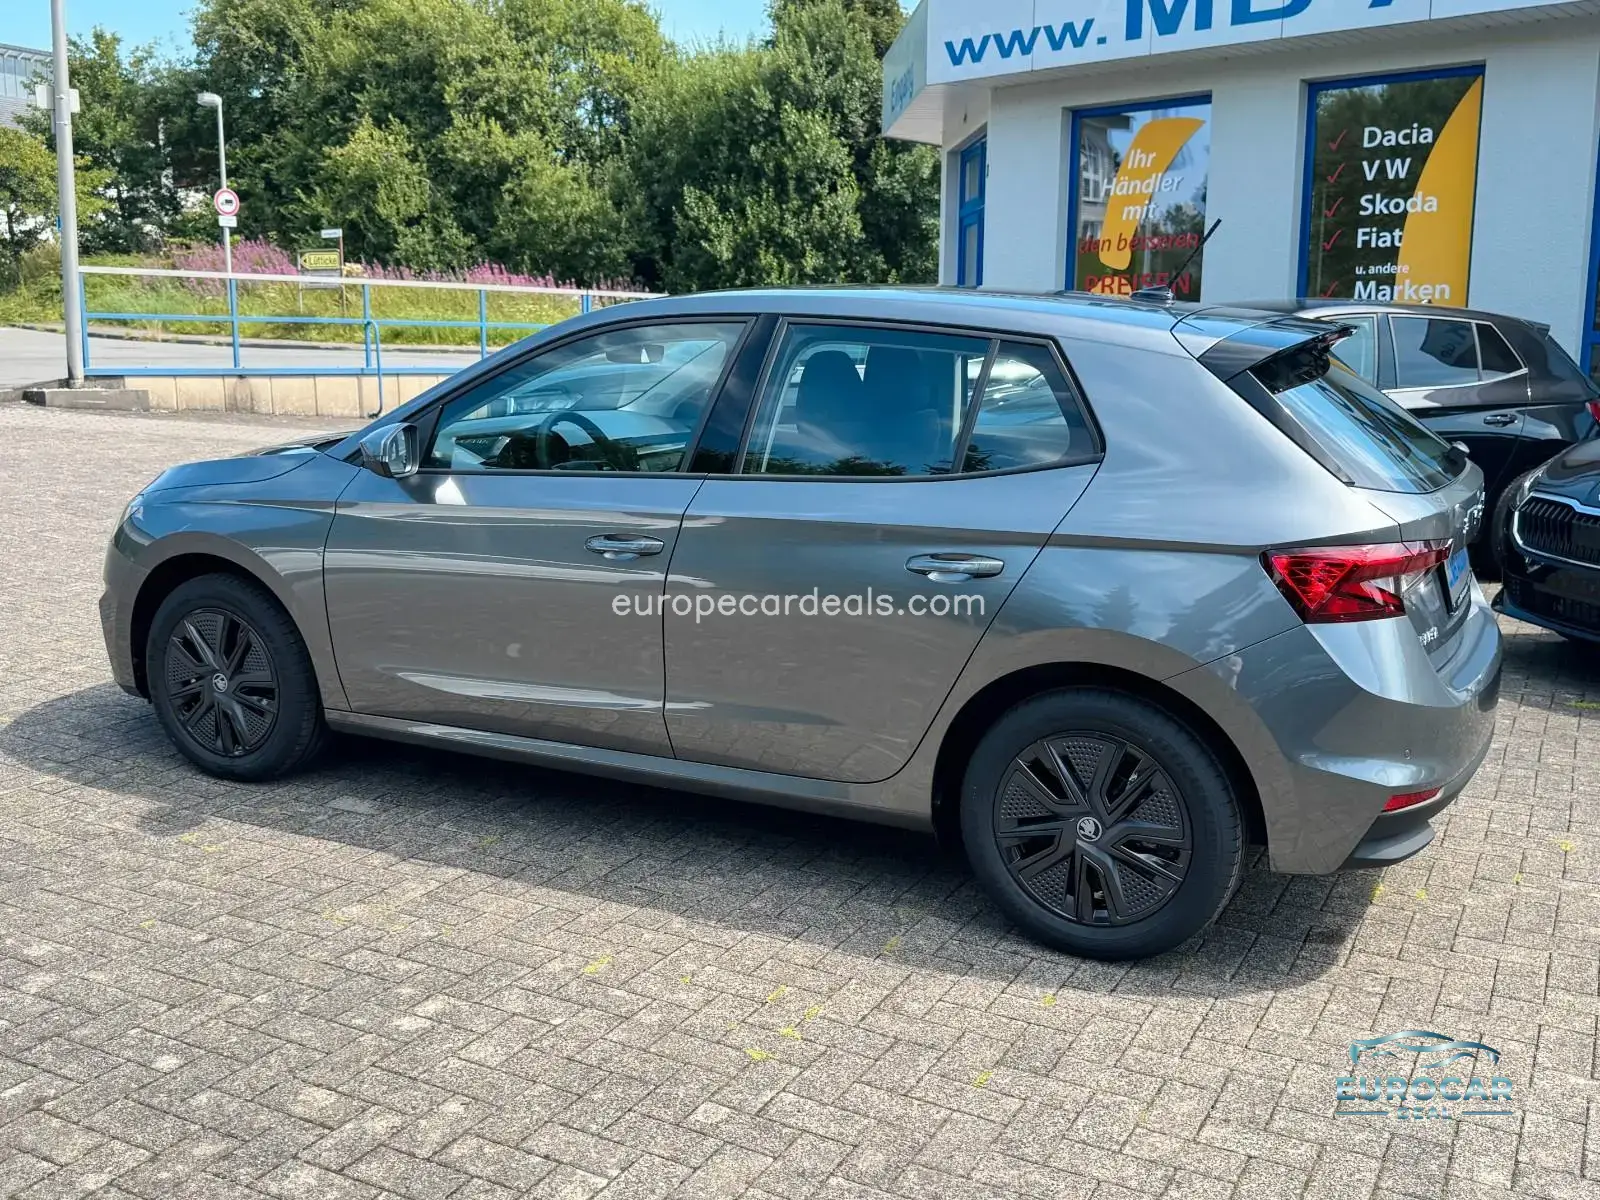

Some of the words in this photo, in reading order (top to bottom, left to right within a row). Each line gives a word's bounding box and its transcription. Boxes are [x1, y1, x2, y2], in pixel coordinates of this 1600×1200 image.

[1363, 123, 1434, 149] Dacia
[1127, 148, 1157, 170] Ihr
[1101, 172, 1185, 197] Händler
[1122, 199, 1159, 221] mit
[1358, 191, 1438, 217] Skoda
[1356, 227, 1404, 249] Fiat
[1355, 265, 1366, 275] u.
[1368, 262, 1410, 275] andere
[1083, 271, 1193, 296] PREISEN
[1353, 279, 1451, 302] Marken
